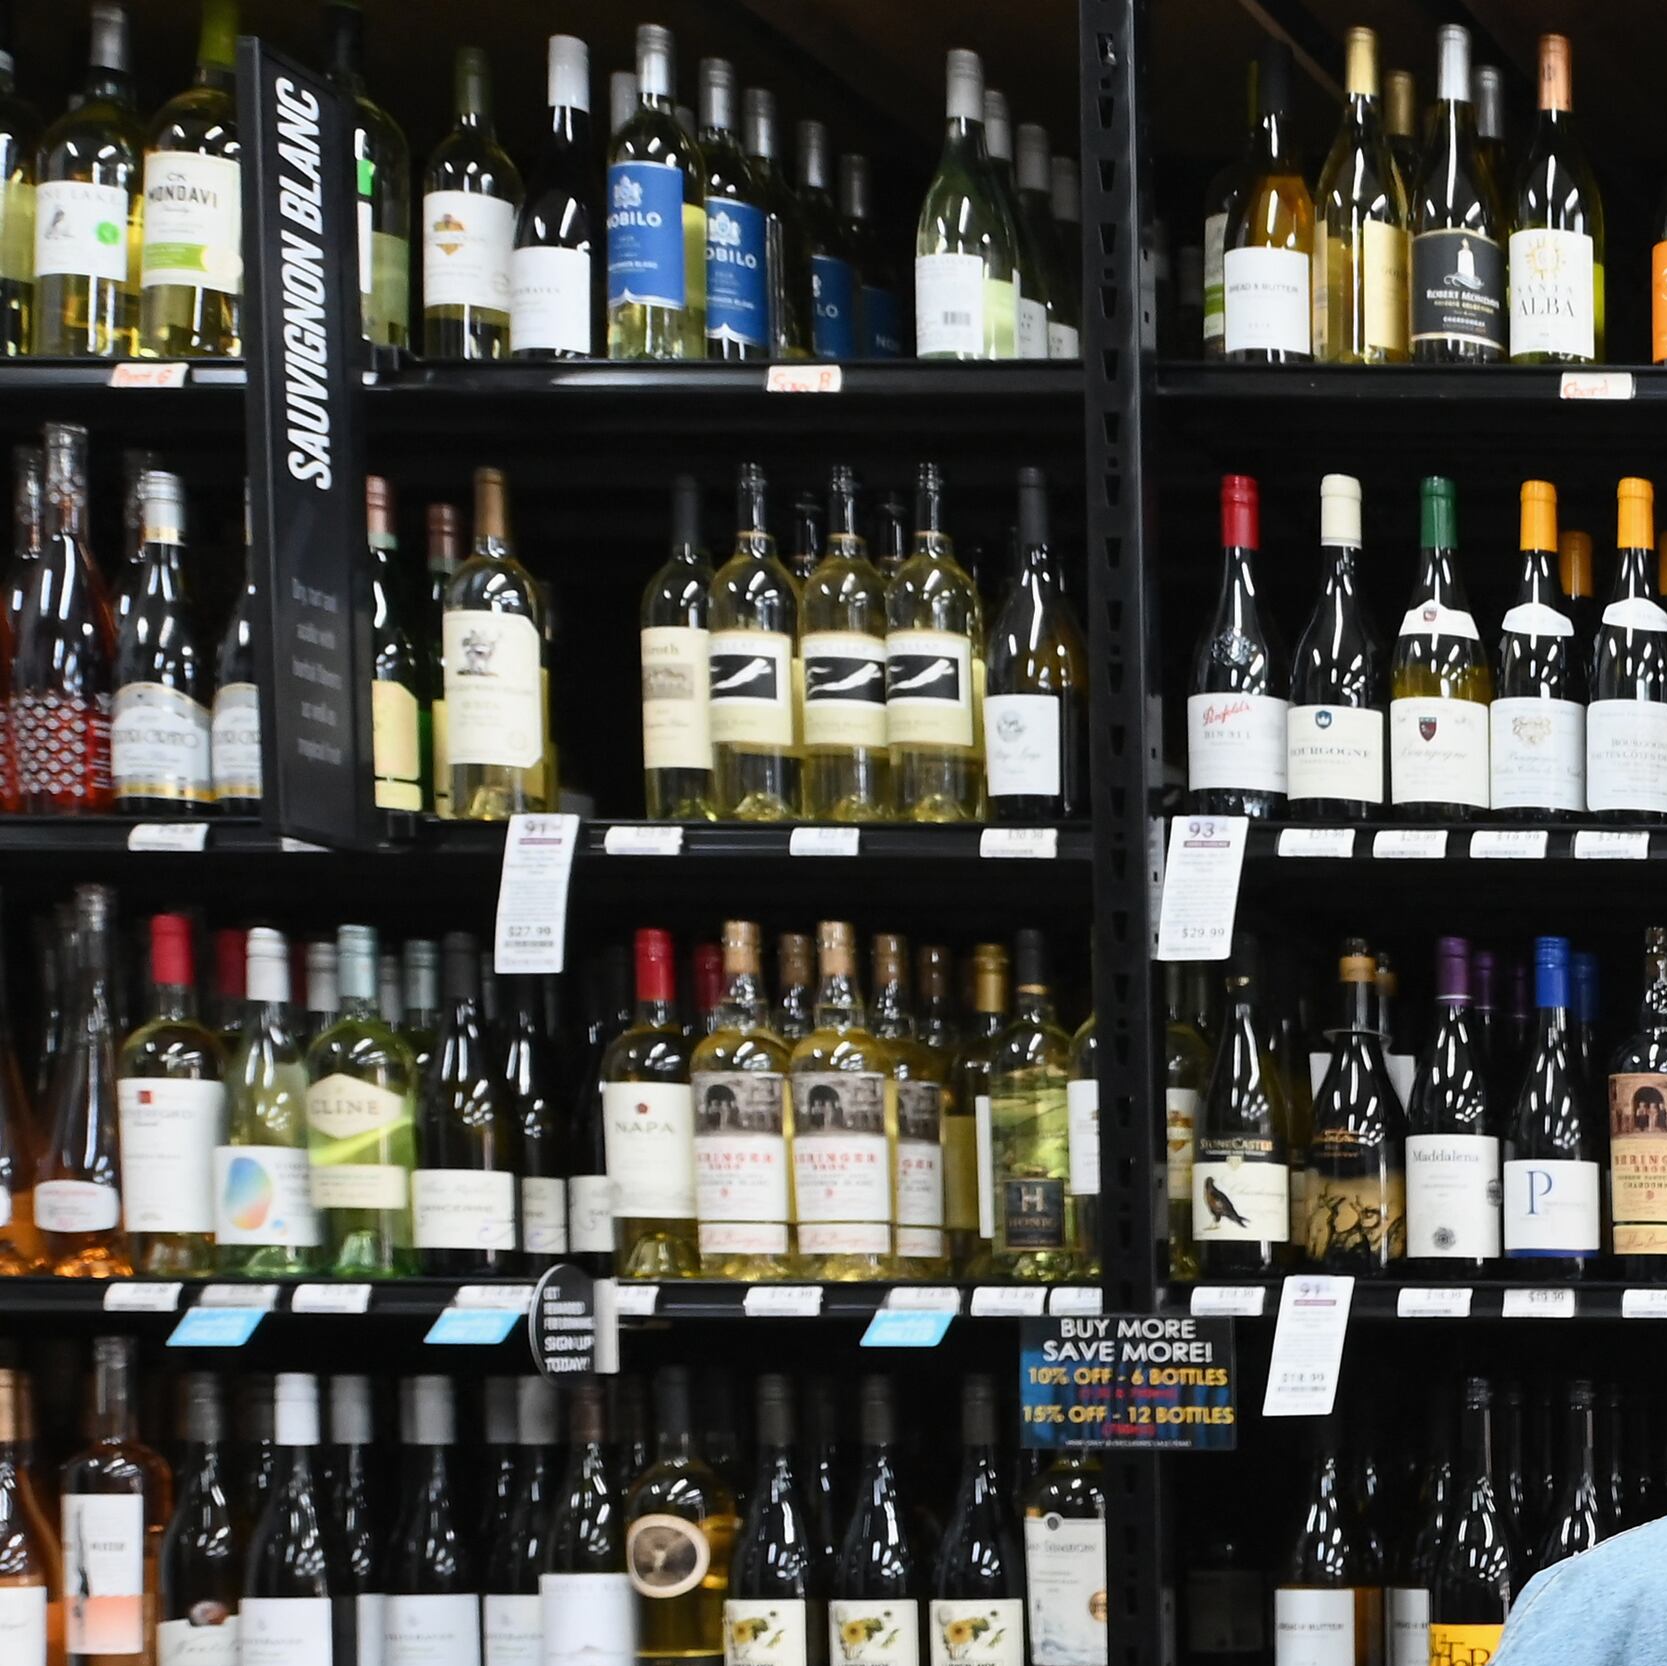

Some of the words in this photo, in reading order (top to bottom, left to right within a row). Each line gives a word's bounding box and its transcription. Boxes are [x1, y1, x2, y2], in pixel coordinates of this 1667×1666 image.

[275, 77, 324, 234] BLANC
[1517, 298, 1575, 319] ALBA
[282, 230, 331, 491] SAUVIGNON
[1289, 748, 1372, 762] BOURGOGNE
[1189, 822, 1216, 839] 93
[1182, 928, 1225, 940] $29.99
[310, 1099, 381, 1117] CLINE
[614, 1121, 674, 1135] NAPA
[1412, 1149, 1479, 1163] Maddalena
[1021, 1186, 1043, 1212] H
[1525, 1169, 1553, 1215] P
[1060, 1319, 1109, 1339] BUY
[1117, 1319, 1197, 1339] MORE
[1043, 1341, 1114, 1362] SAVE
[1121, 1341, 1213, 1363] MORE!
[1028, 1367, 1069, 1385] 10%
[1074, 1367, 1112, 1385] OFF
[1131, 1367, 1144, 1385] 6
[1150, 1368, 1228, 1386] BOTTLES
[1023, 1407, 1065, 1424] 15%
[1068, 1407, 1107, 1424] OFF
[1128, 1407, 1150, 1424] 12
[1156, 1407, 1235, 1424] BOTTLES
